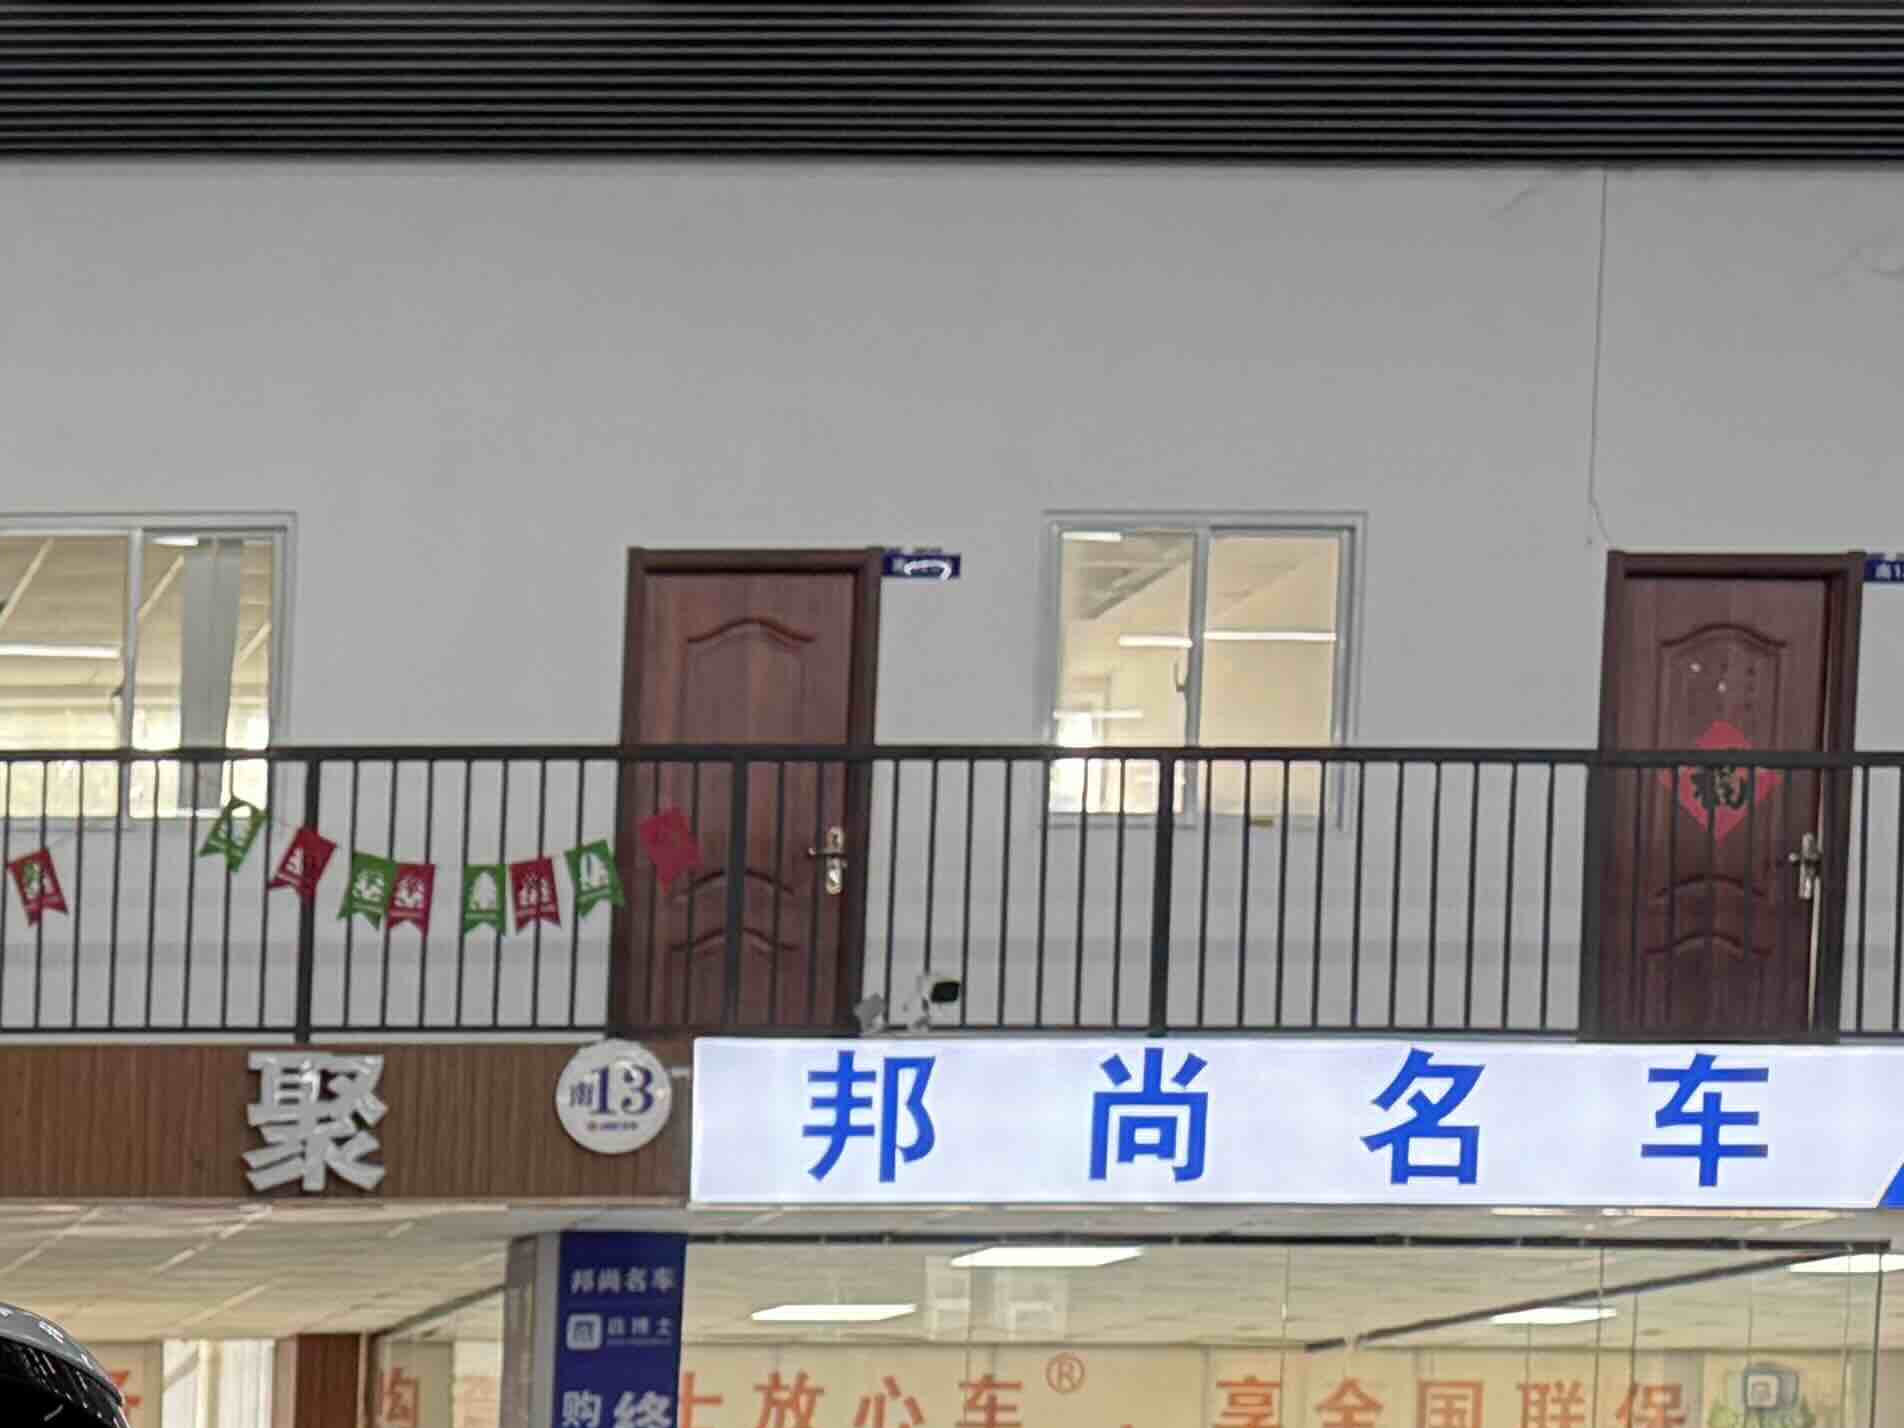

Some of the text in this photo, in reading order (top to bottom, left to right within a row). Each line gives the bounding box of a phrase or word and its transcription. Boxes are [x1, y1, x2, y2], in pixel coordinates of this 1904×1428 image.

[241, 1049, 387, 1192] 聚
[803, 1047, 1770, 1188] 邦尚名车
